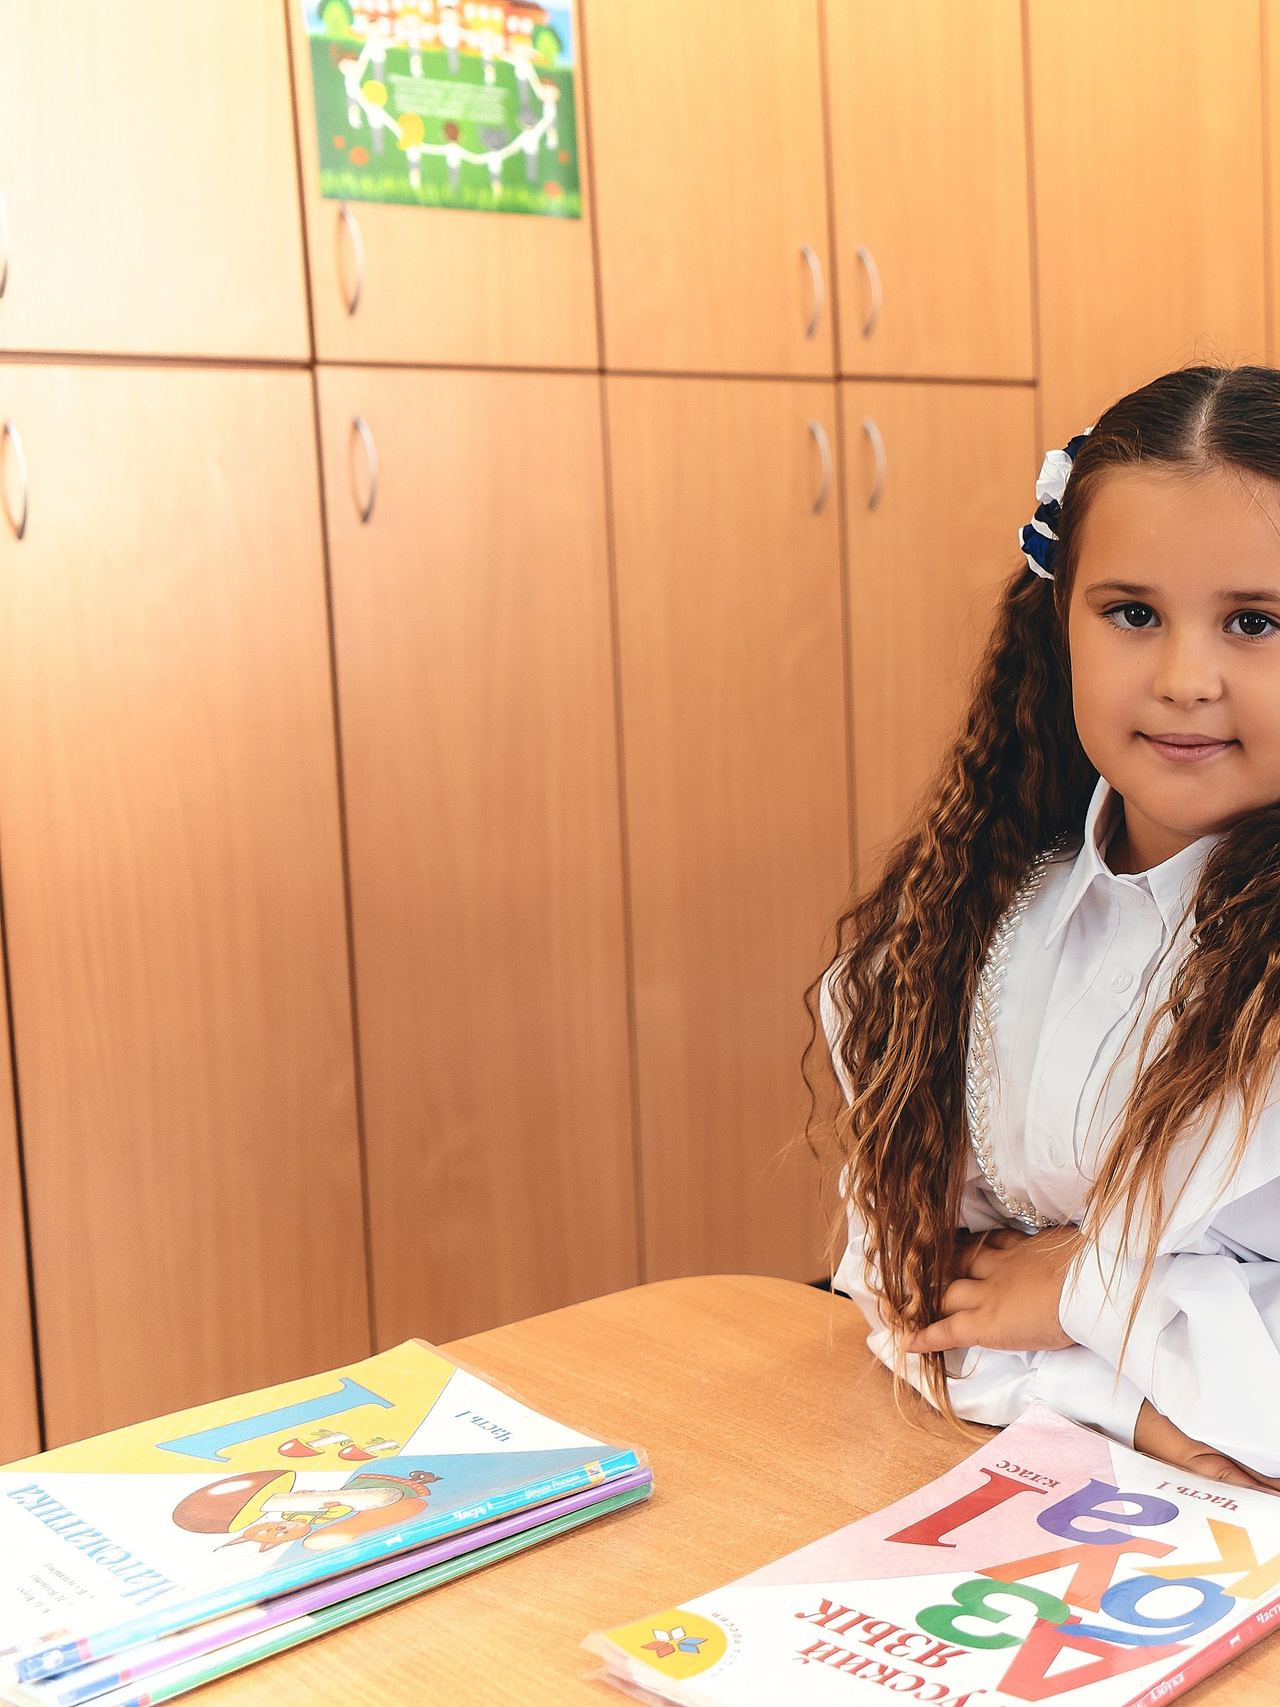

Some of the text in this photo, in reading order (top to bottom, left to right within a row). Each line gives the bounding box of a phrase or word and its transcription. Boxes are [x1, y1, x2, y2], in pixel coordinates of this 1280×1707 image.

[470, 1415, 513, 1443] Часть
[995, 1459, 1061, 1489] класс
[884, 1468, 1048, 1549] 1
[1172, 1484, 1239, 1512] Часть
[791, 1639, 997, 1707] усский
